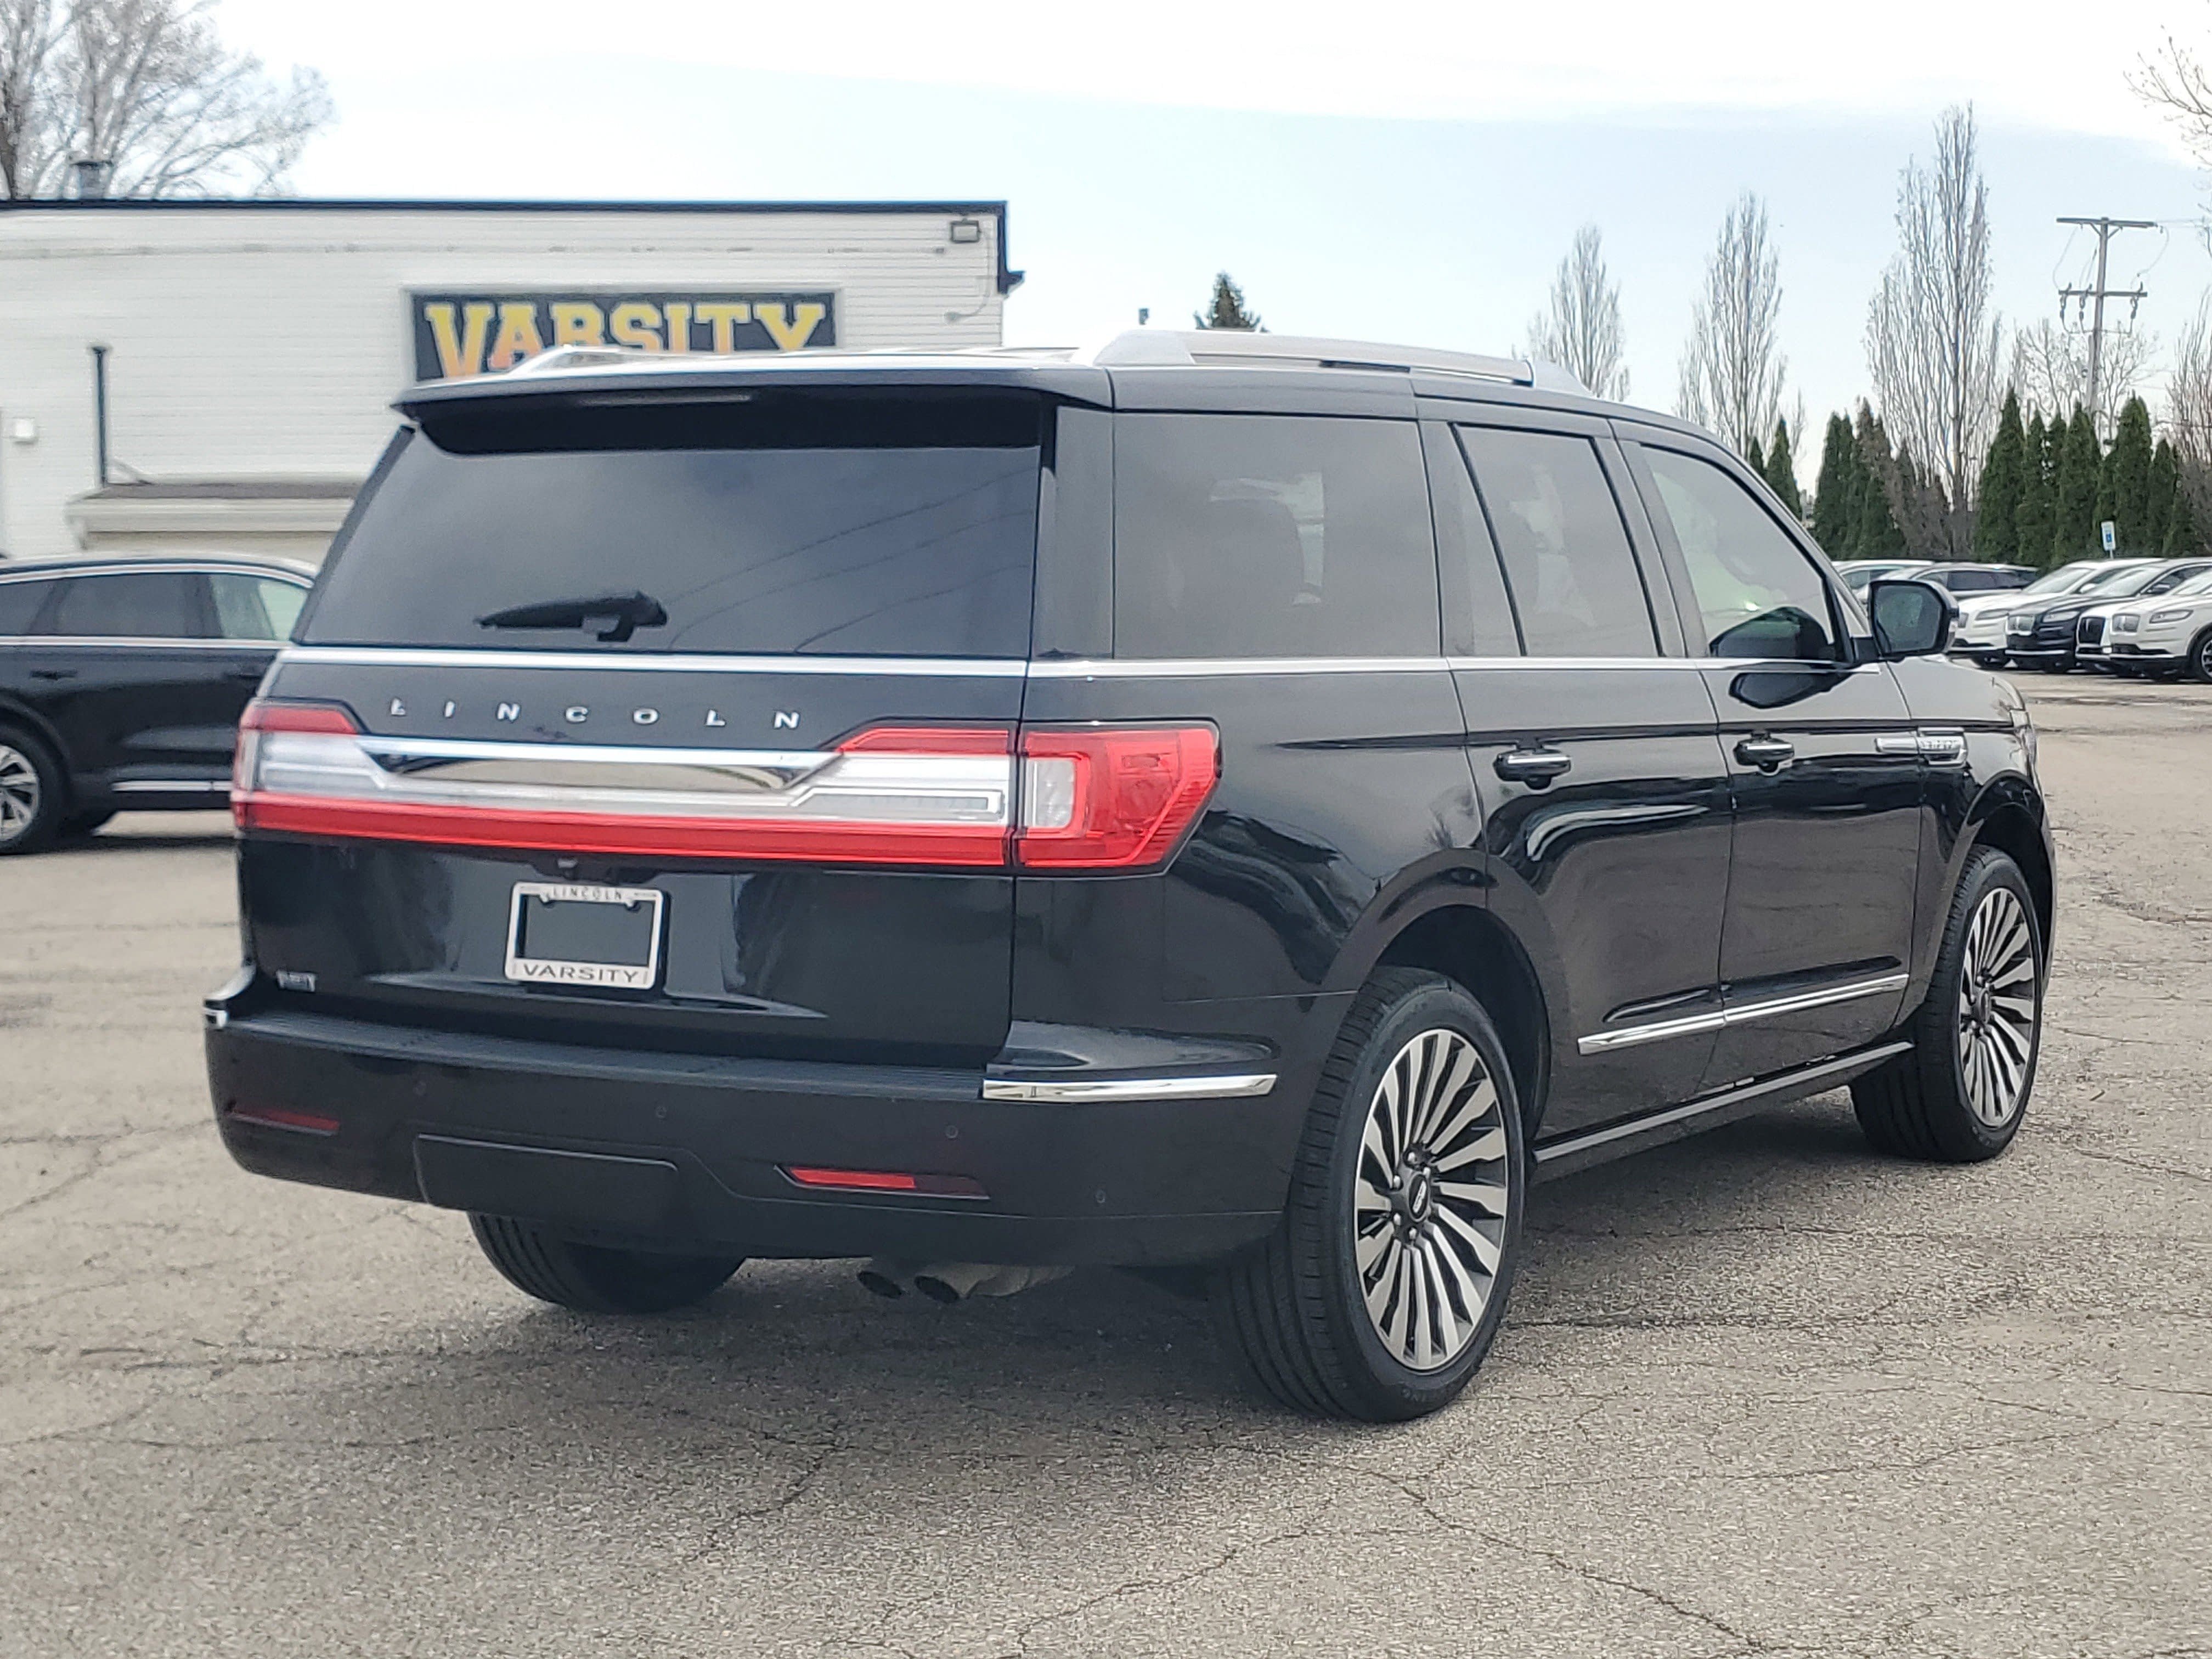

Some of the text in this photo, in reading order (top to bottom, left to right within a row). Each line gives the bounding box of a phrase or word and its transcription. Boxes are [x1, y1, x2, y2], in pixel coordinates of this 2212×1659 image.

[425, 301, 826, 377] VARSITY
[390, 697, 800, 730] LINCOLN
[552, 887, 623, 900] LINCOLN
[523, 964, 639, 983] VARSITY
